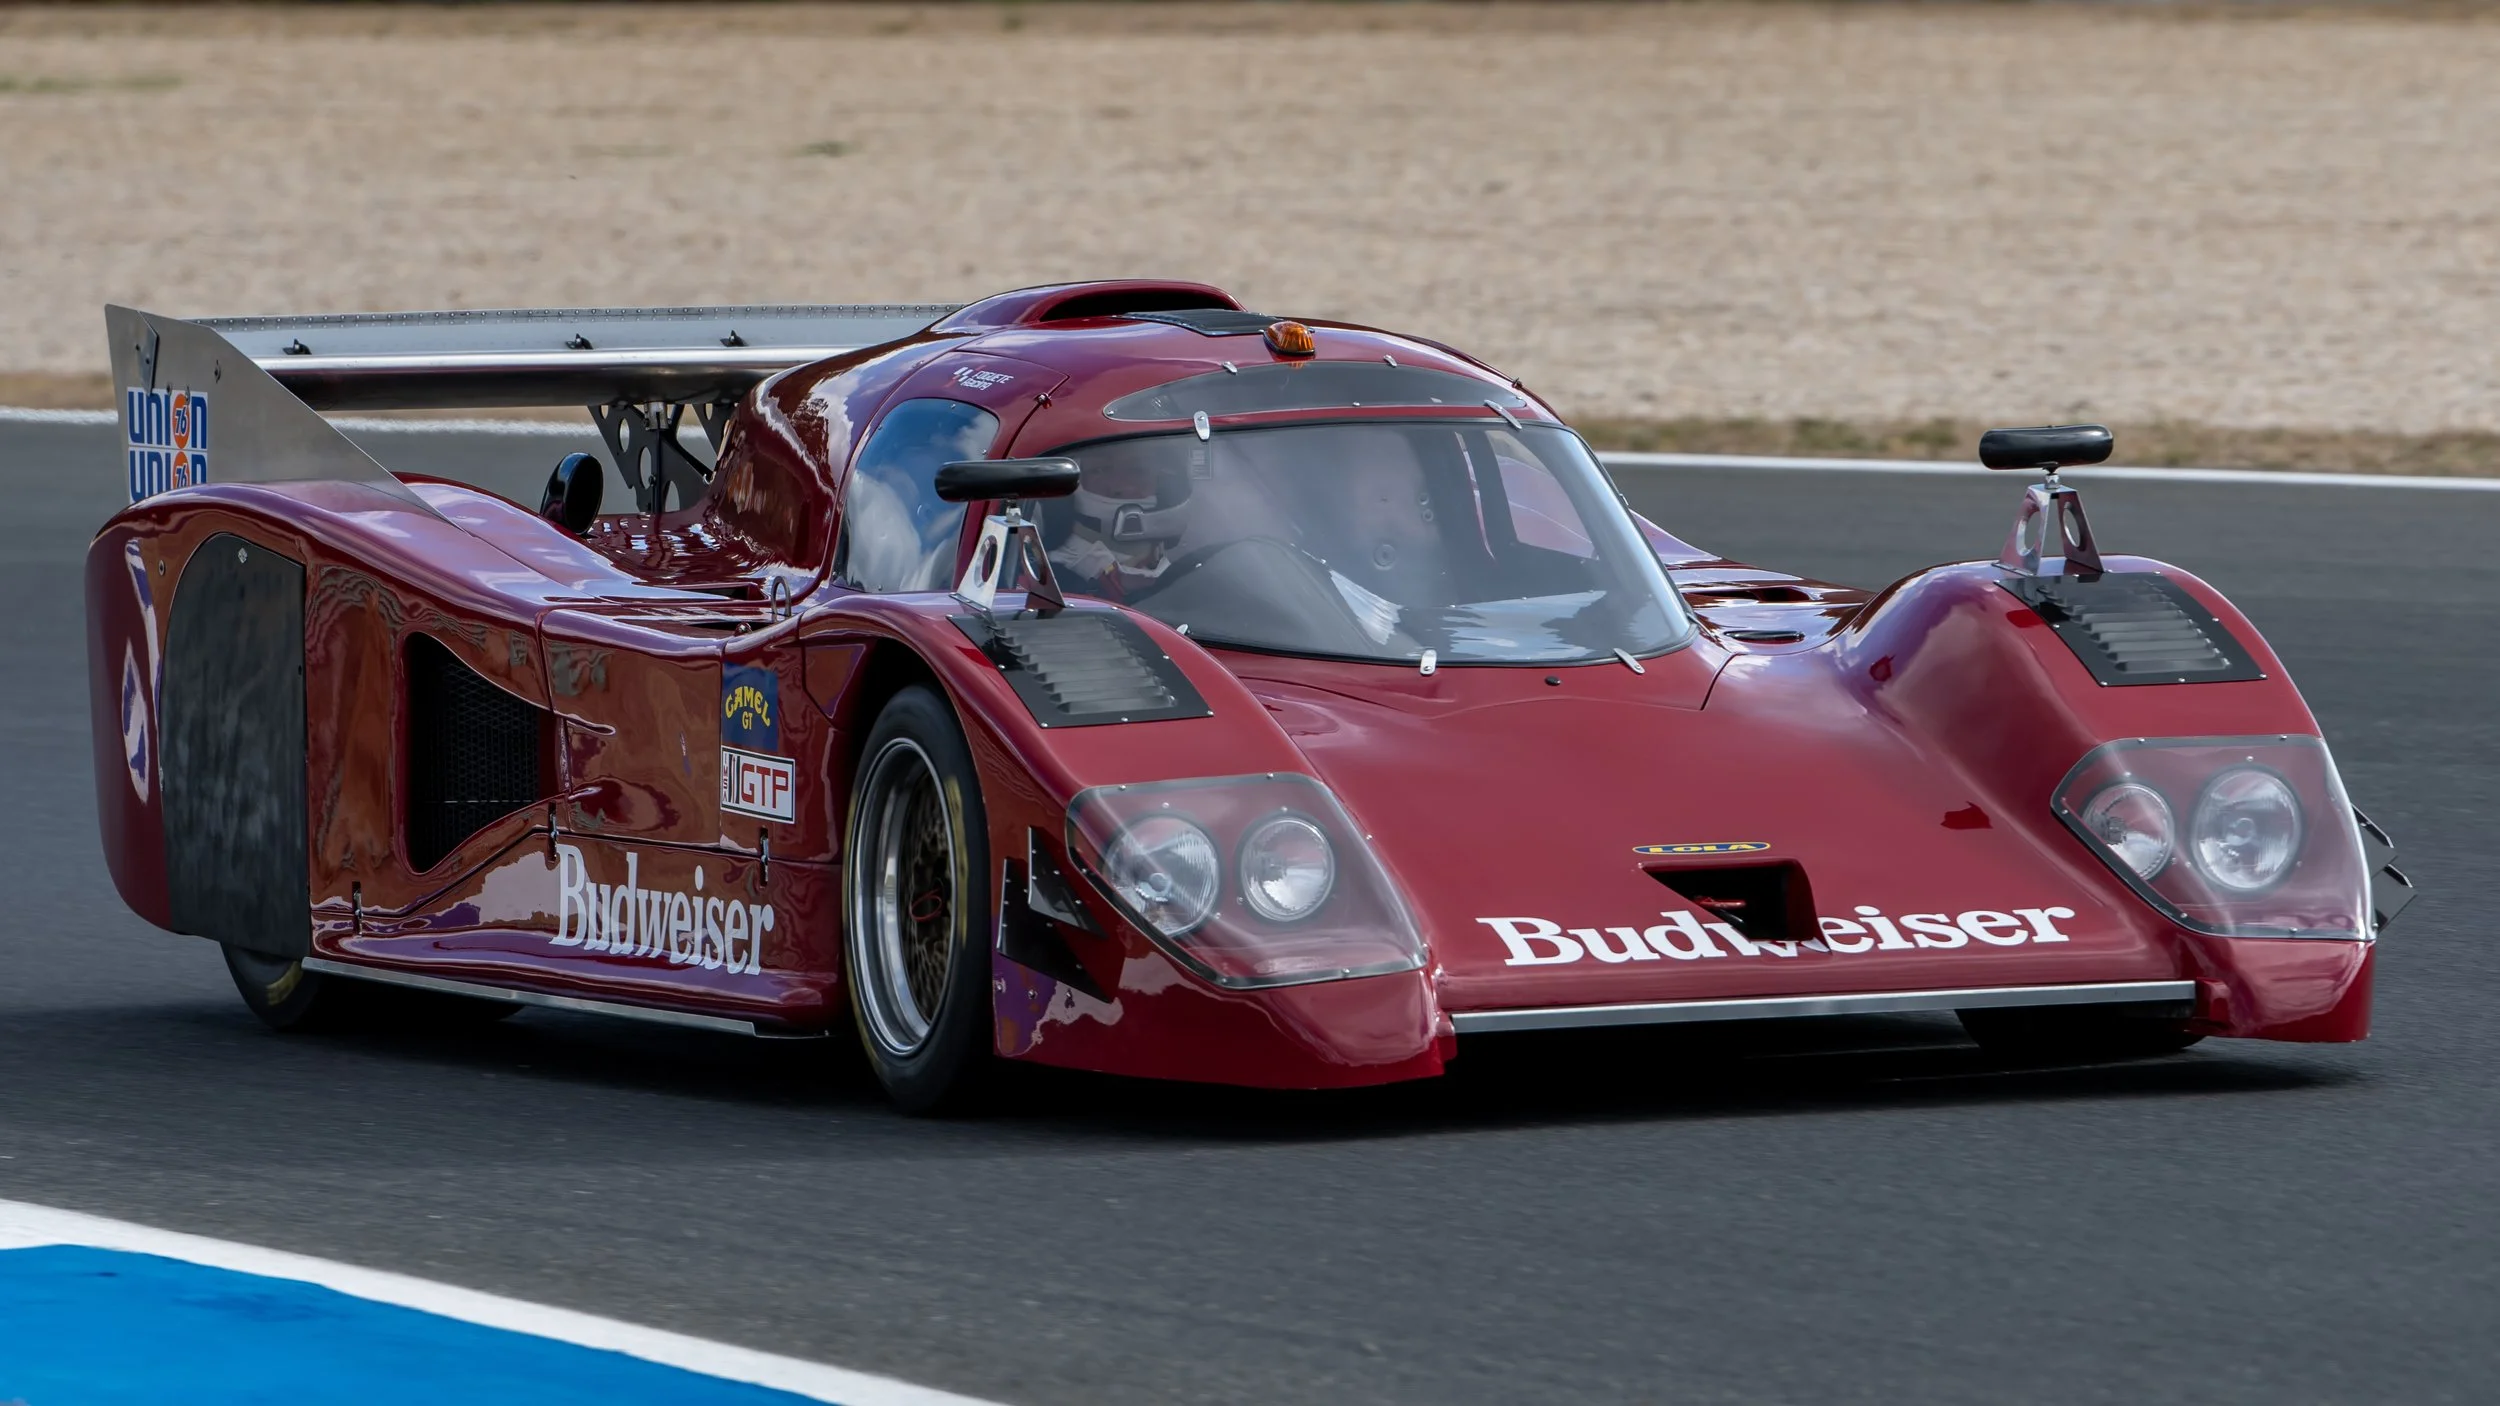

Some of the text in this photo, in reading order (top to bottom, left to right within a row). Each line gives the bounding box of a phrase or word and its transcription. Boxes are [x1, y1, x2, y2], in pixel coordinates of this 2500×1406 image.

[725, 686, 771, 728] CAMEL
[742, 711, 753, 730] GT
[741, 763, 789, 809] GTP
[1649, 844, 1757, 853] LOLA
[549, 843, 774, 976] Budweiser
